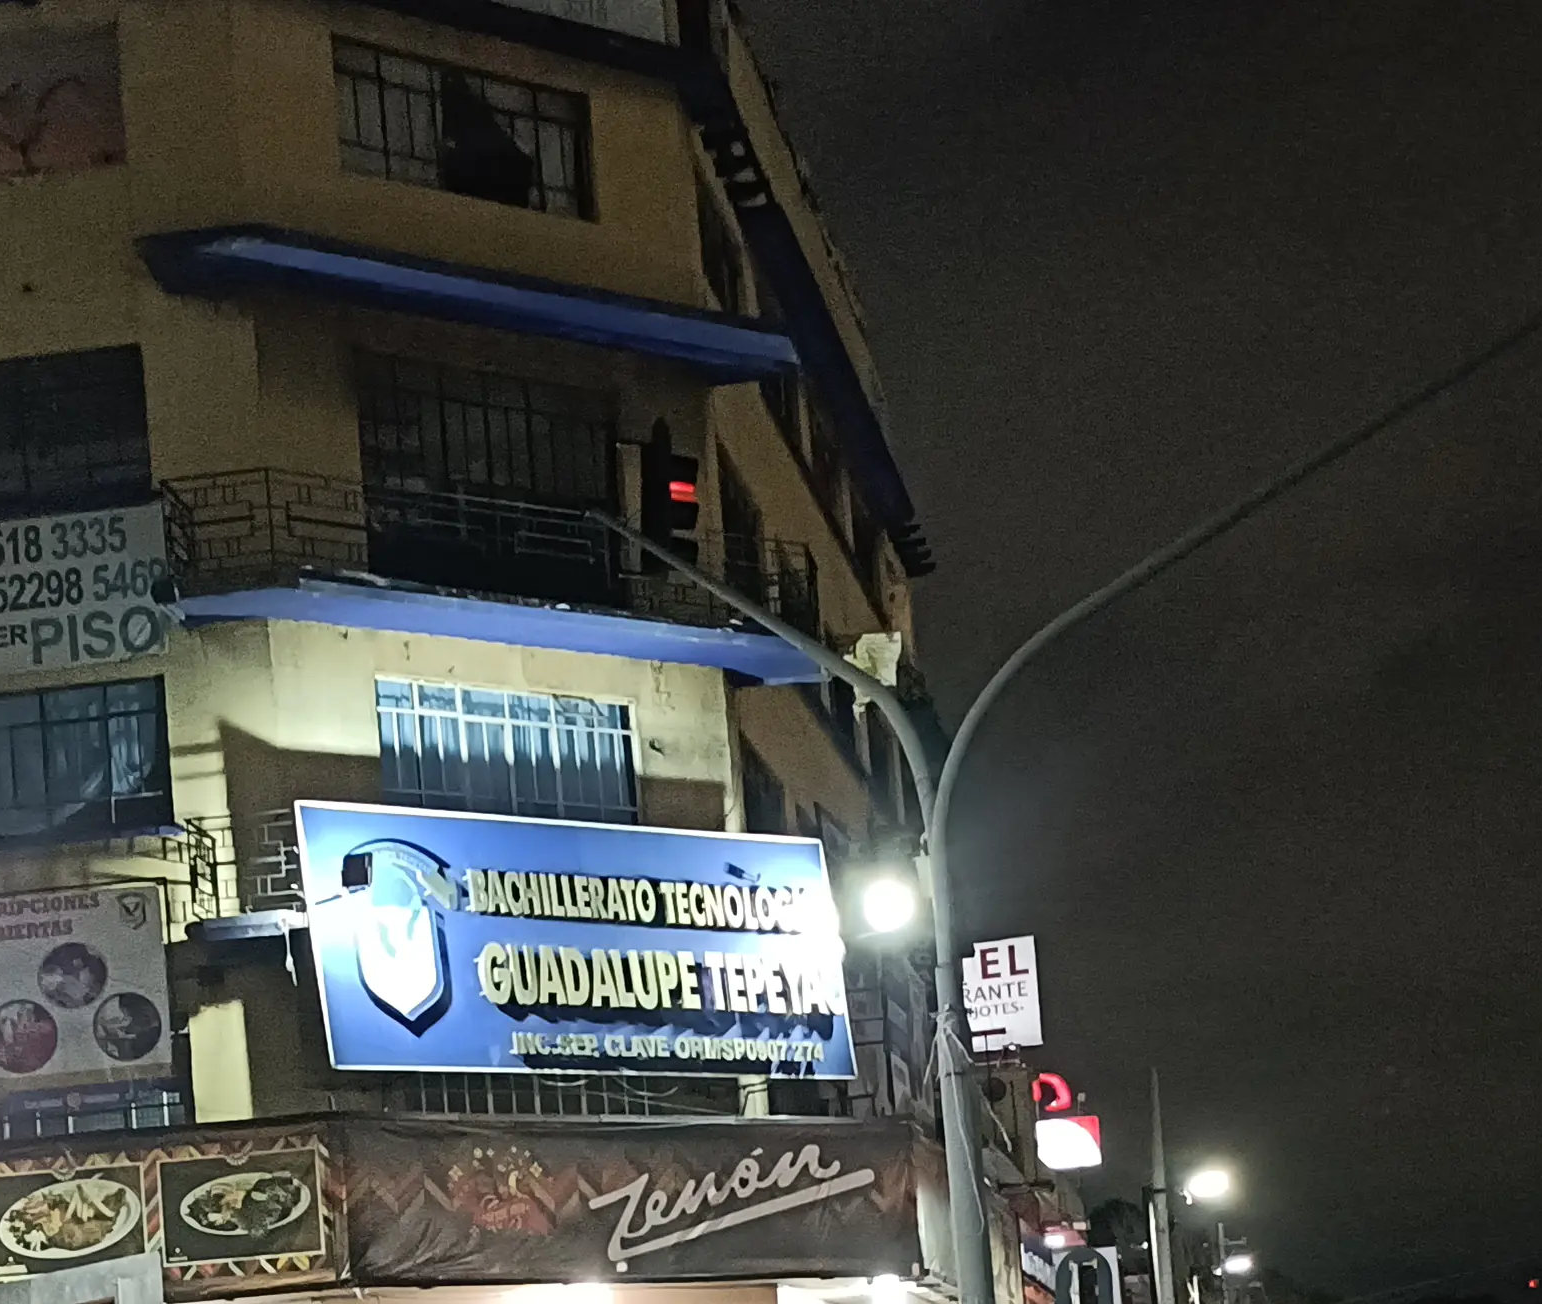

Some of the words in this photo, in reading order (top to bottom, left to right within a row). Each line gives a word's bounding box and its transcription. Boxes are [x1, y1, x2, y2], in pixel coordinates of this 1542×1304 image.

[51, 516, 127, 560] 3335
[31, 605, 162, 665] PISO
[466, 868, 656, 924] BACHILLERATO
[659, 881, 825, 935] TECNOLOG
[478, 942, 703, 1011] GUADALUPE
[604, 1035, 671, 1059] CLAVE
[589, 1143, 857, 1265] Zenón
